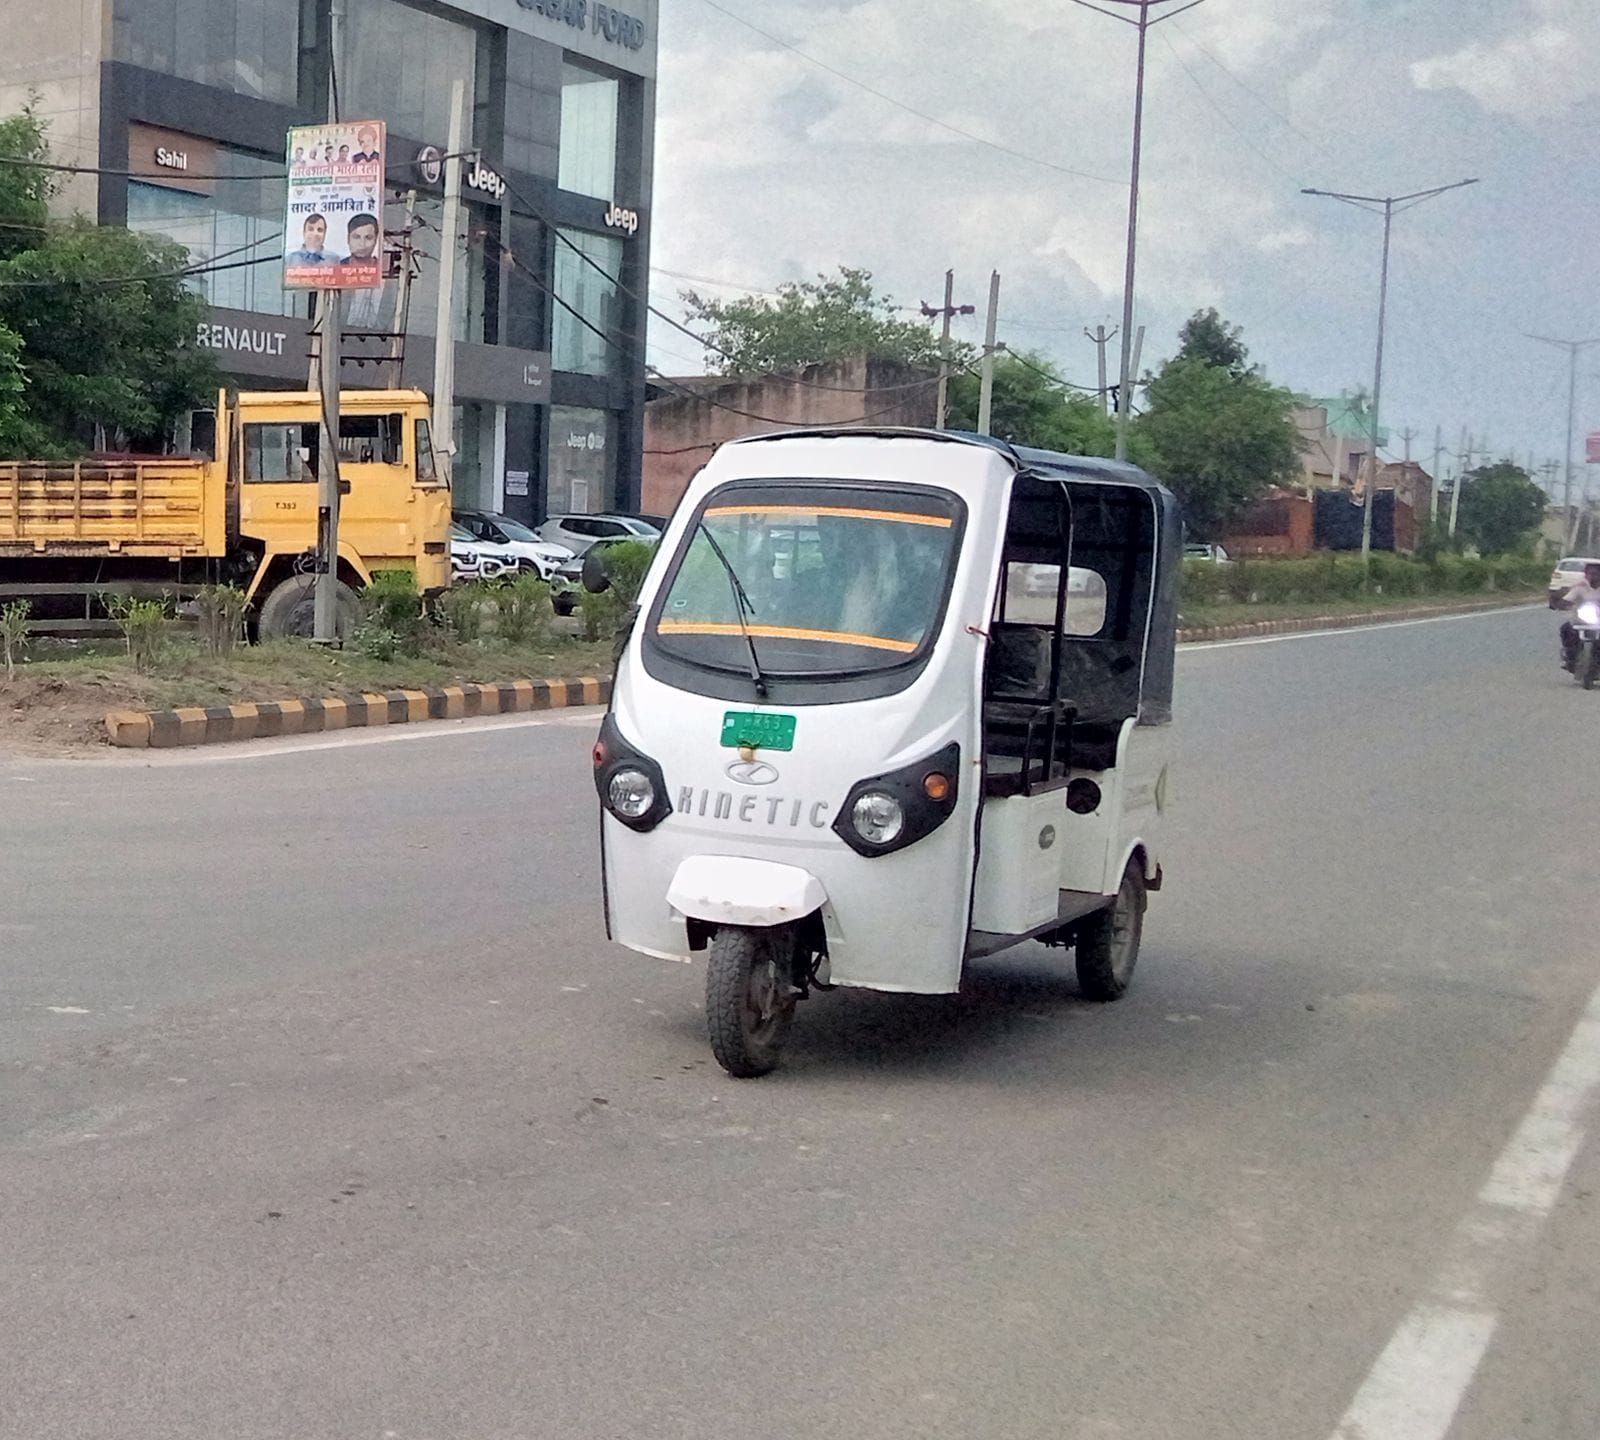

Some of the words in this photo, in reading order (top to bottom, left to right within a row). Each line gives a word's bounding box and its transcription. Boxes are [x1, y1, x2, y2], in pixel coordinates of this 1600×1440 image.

[592, 3, 646, 51] FORD
[156, 147, 187, 170] Sahil
[468, 160, 506, 199] Jeep
[291, 202, 317, 214] सादर
[321, 198, 364, 213] आमंत्रित
[604, 202, 638, 234] Jeep
[196, 322, 287, 355] RENAULT
[567, 431, 587, 451] Jeep
[677, 786, 829, 828] KINETIC
